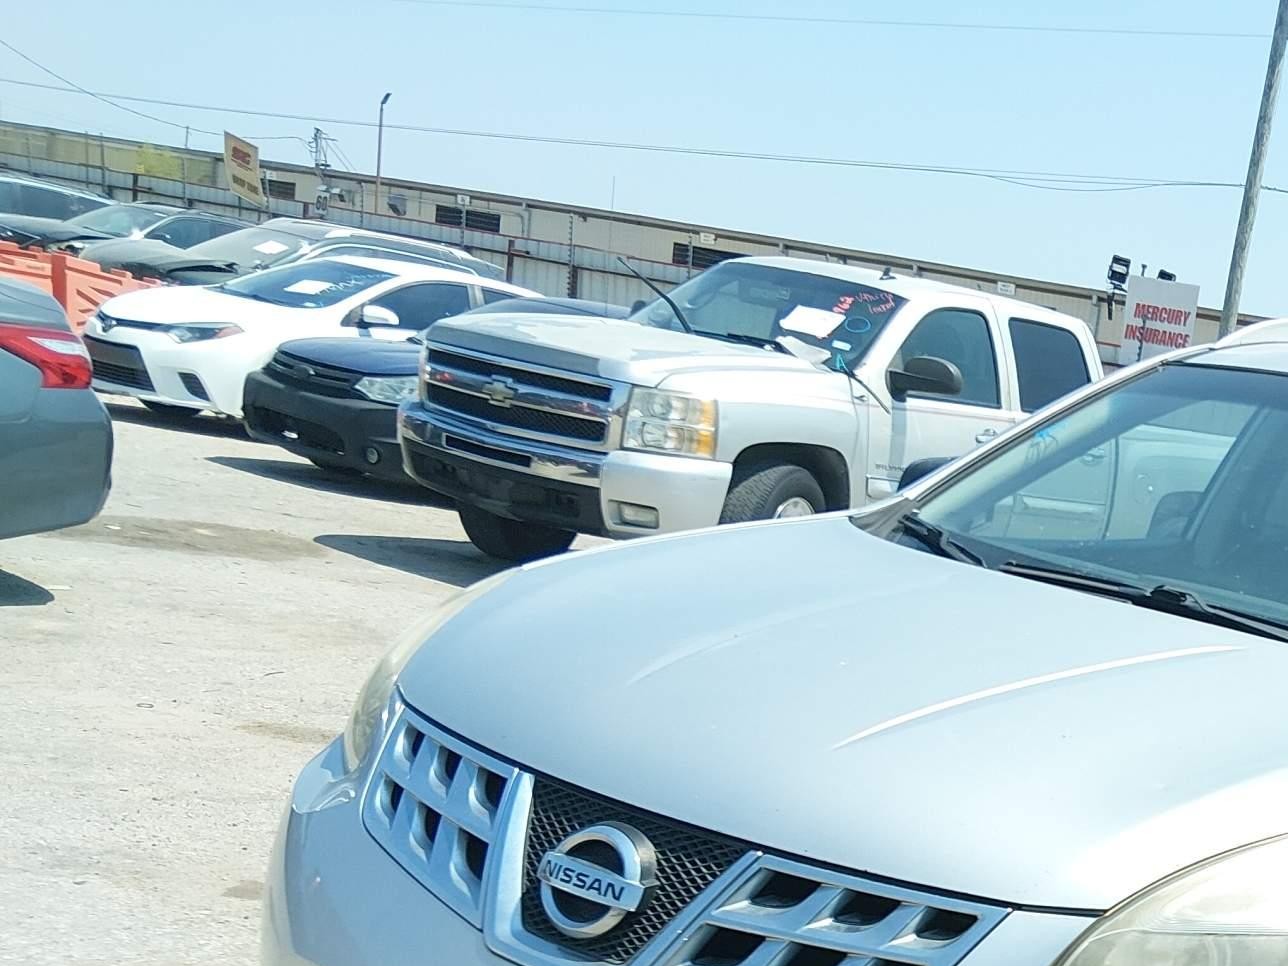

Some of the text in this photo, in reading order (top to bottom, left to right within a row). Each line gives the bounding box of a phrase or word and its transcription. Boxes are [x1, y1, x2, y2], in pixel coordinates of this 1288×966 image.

[316, 195, 328, 211] 60
[1133, 303, 1191, 327] MERCURY
[1124, 323, 1190, 349] INSURANCE
[543, 859, 625, 902] NISSAN
